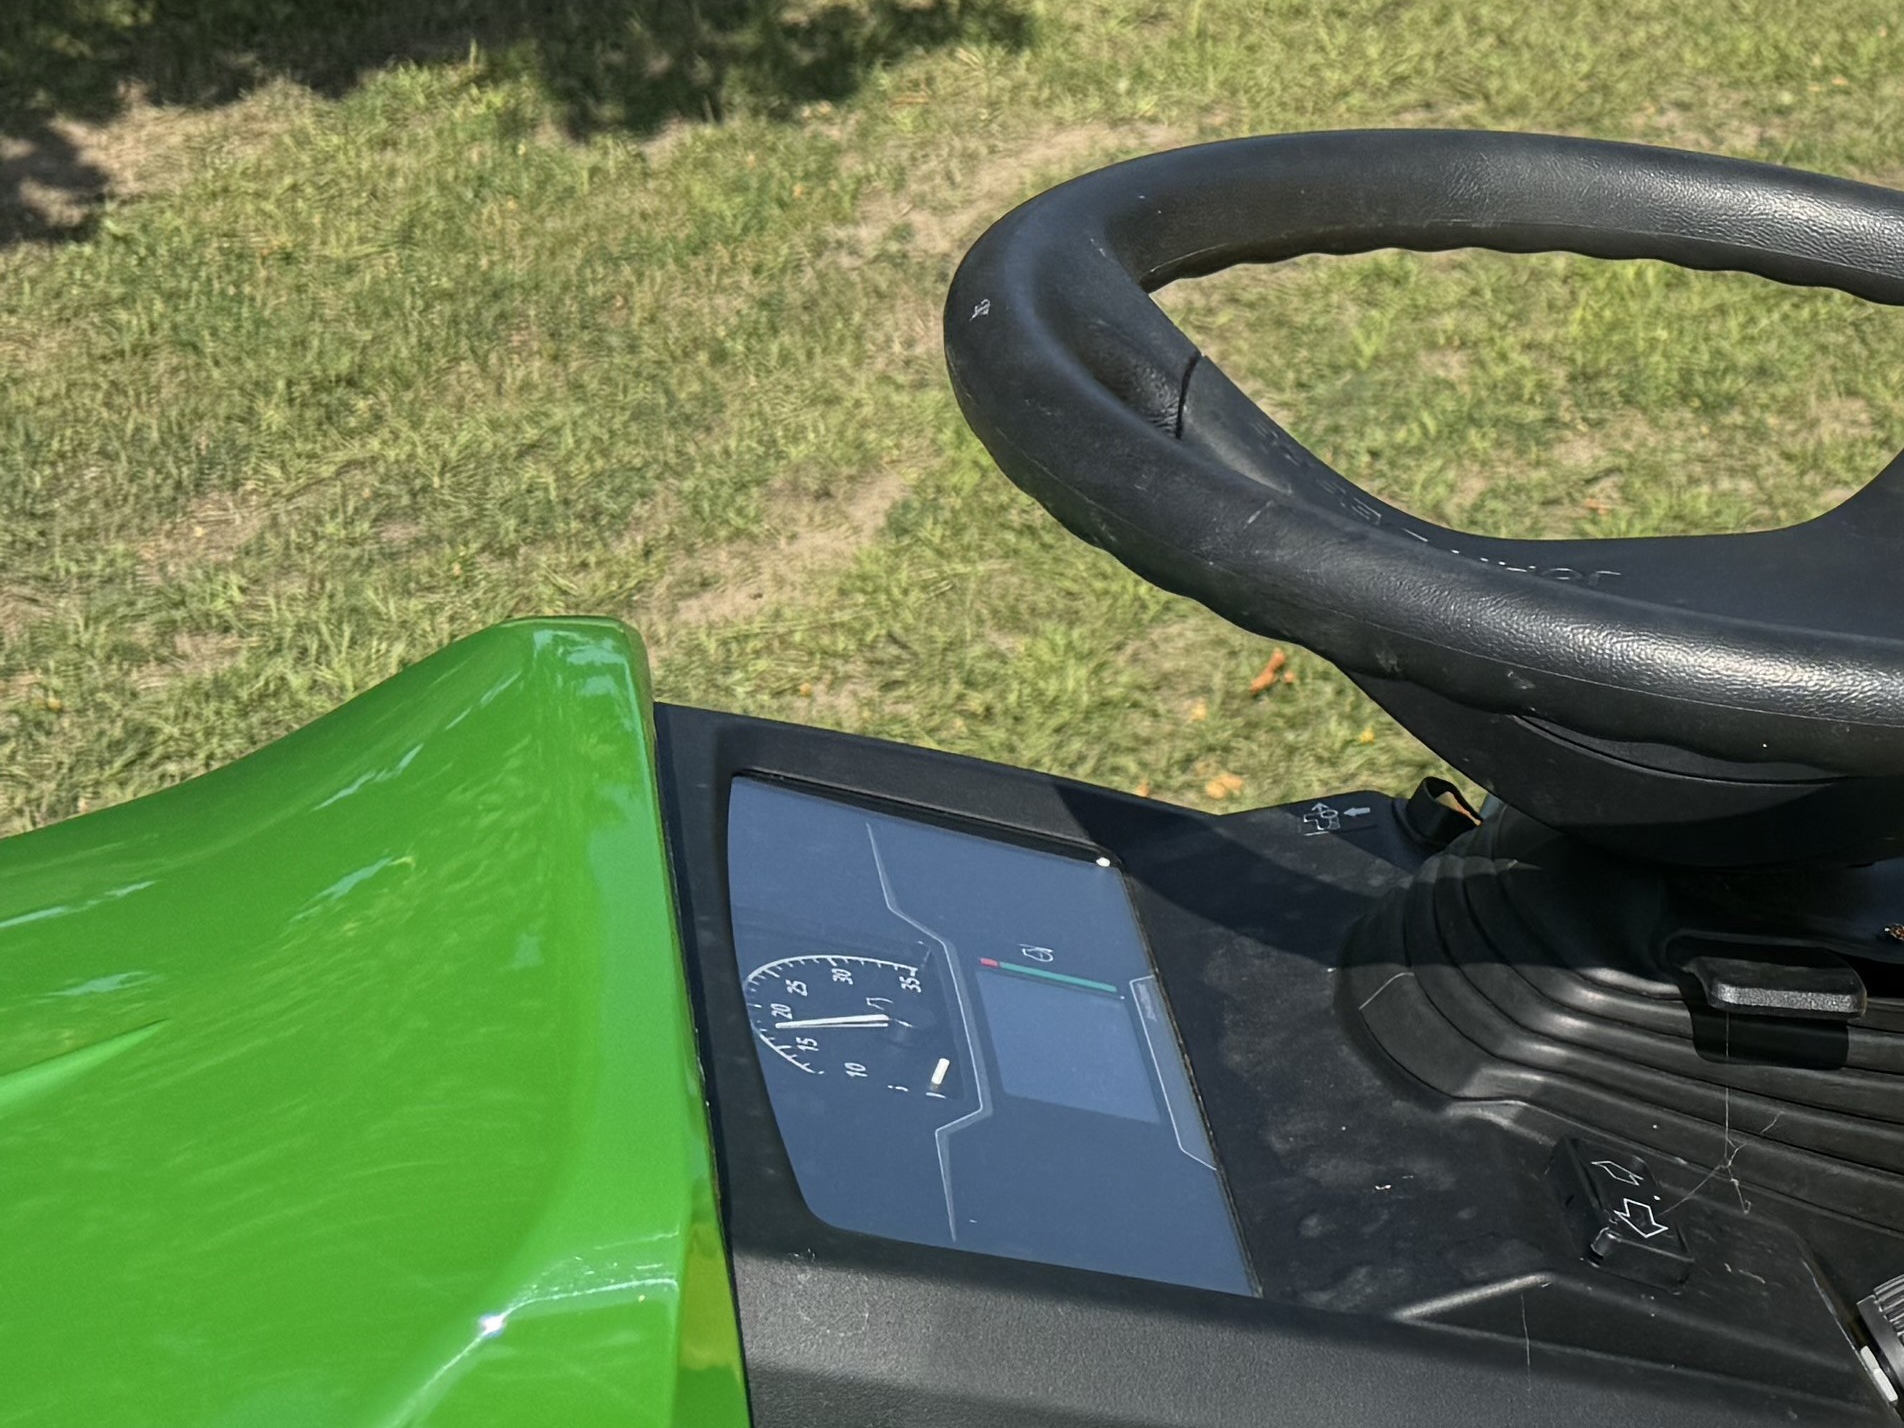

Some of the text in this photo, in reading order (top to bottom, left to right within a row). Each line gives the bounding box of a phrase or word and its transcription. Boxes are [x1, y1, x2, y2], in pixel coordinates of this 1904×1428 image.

[830, 967, 854, 985] 30
[898, 976, 922, 993] 35
[786, 979, 808, 996] 25
[769, 1002, 794, 1020] 20
[795, 1035, 819, 1052] 15
[843, 1061, 868, 1078] 10
